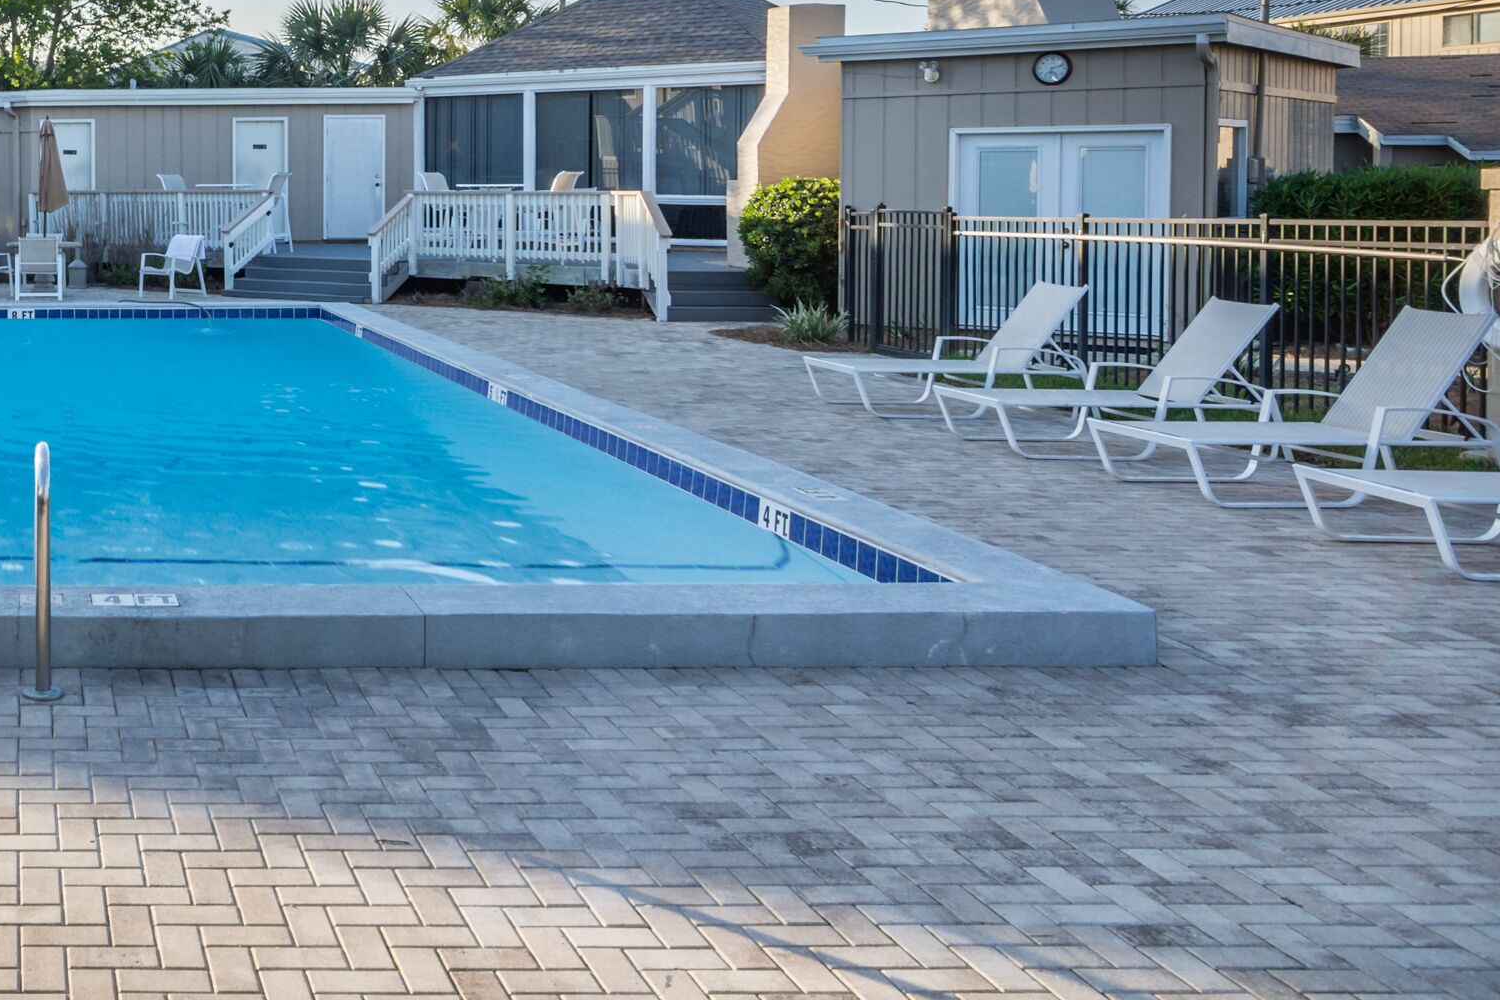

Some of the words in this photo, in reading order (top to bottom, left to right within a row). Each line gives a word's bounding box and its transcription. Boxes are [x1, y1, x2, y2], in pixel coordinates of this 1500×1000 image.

[12, 311, 17, 319] 8
[22, 311, 33, 319] FT
[763, 505, 770, 528] 4
[103, 595, 121, 604] 4
